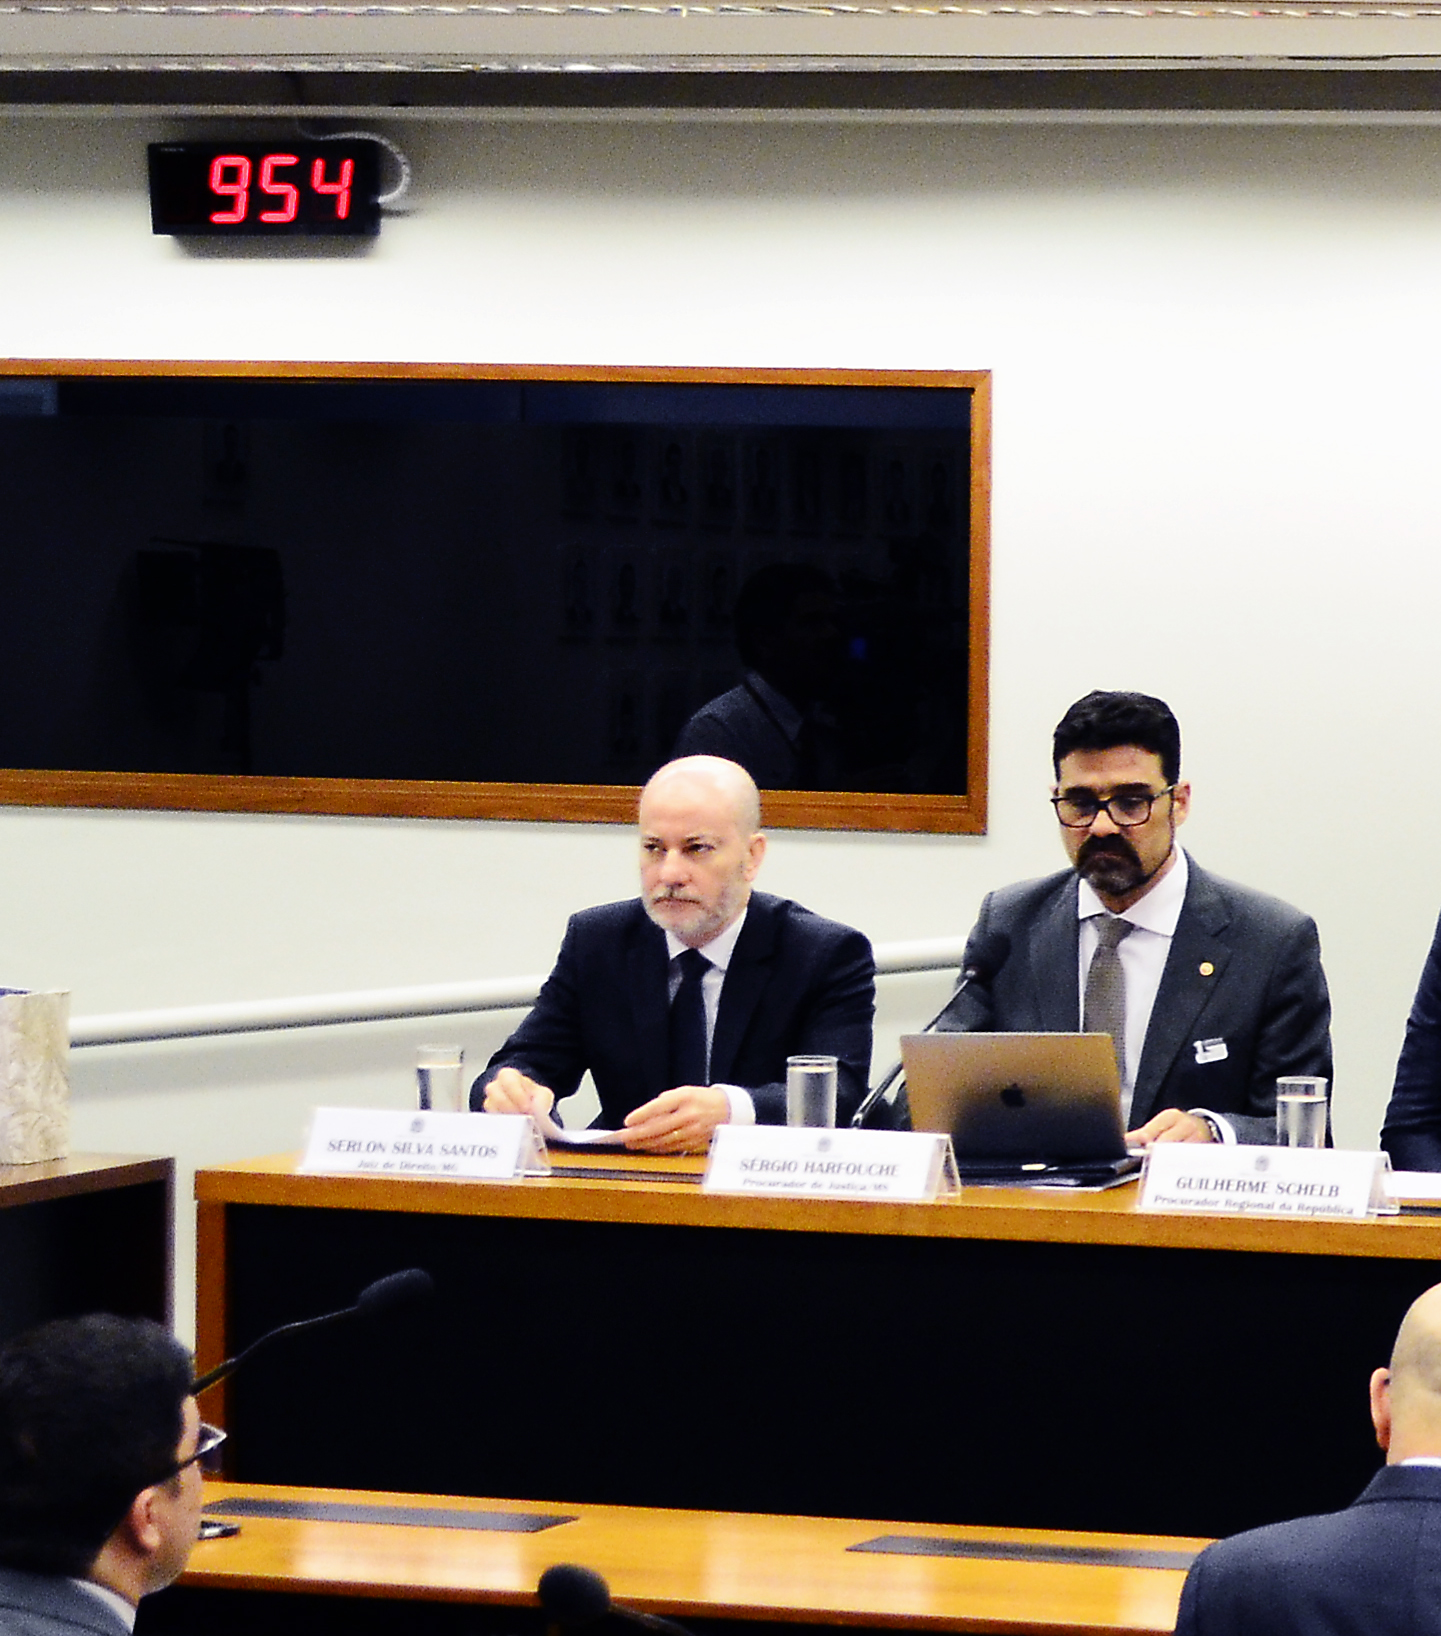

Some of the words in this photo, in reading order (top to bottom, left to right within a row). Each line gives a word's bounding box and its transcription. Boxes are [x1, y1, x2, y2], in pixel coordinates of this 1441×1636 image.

[209, 154, 355, 224] 954
[328, 1139, 387, 1154] SERLON
[393, 1143, 434, 1156] SILVA
[440, 1144, 498, 1158] SANTOS
[383, 1161, 395, 1169] de
[740, 1156, 798, 1172] SÉRGIO
[804, 1162, 898, 1176] HARFOUCHE
[743, 1179, 806, 1189] Procurador
[811, 1181, 823, 1189] de
[1176, 1177, 1269, 1194] GUILHERME
[1276, 1183, 1340, 1197] SCHELB
[1154, 1195, 1220, 1206] Procurador
[1224, 1199, 1275, 1211] Regional
[1279, 1203, 1292, 1211] da
[1297, 1203, 1354, 1216] República
